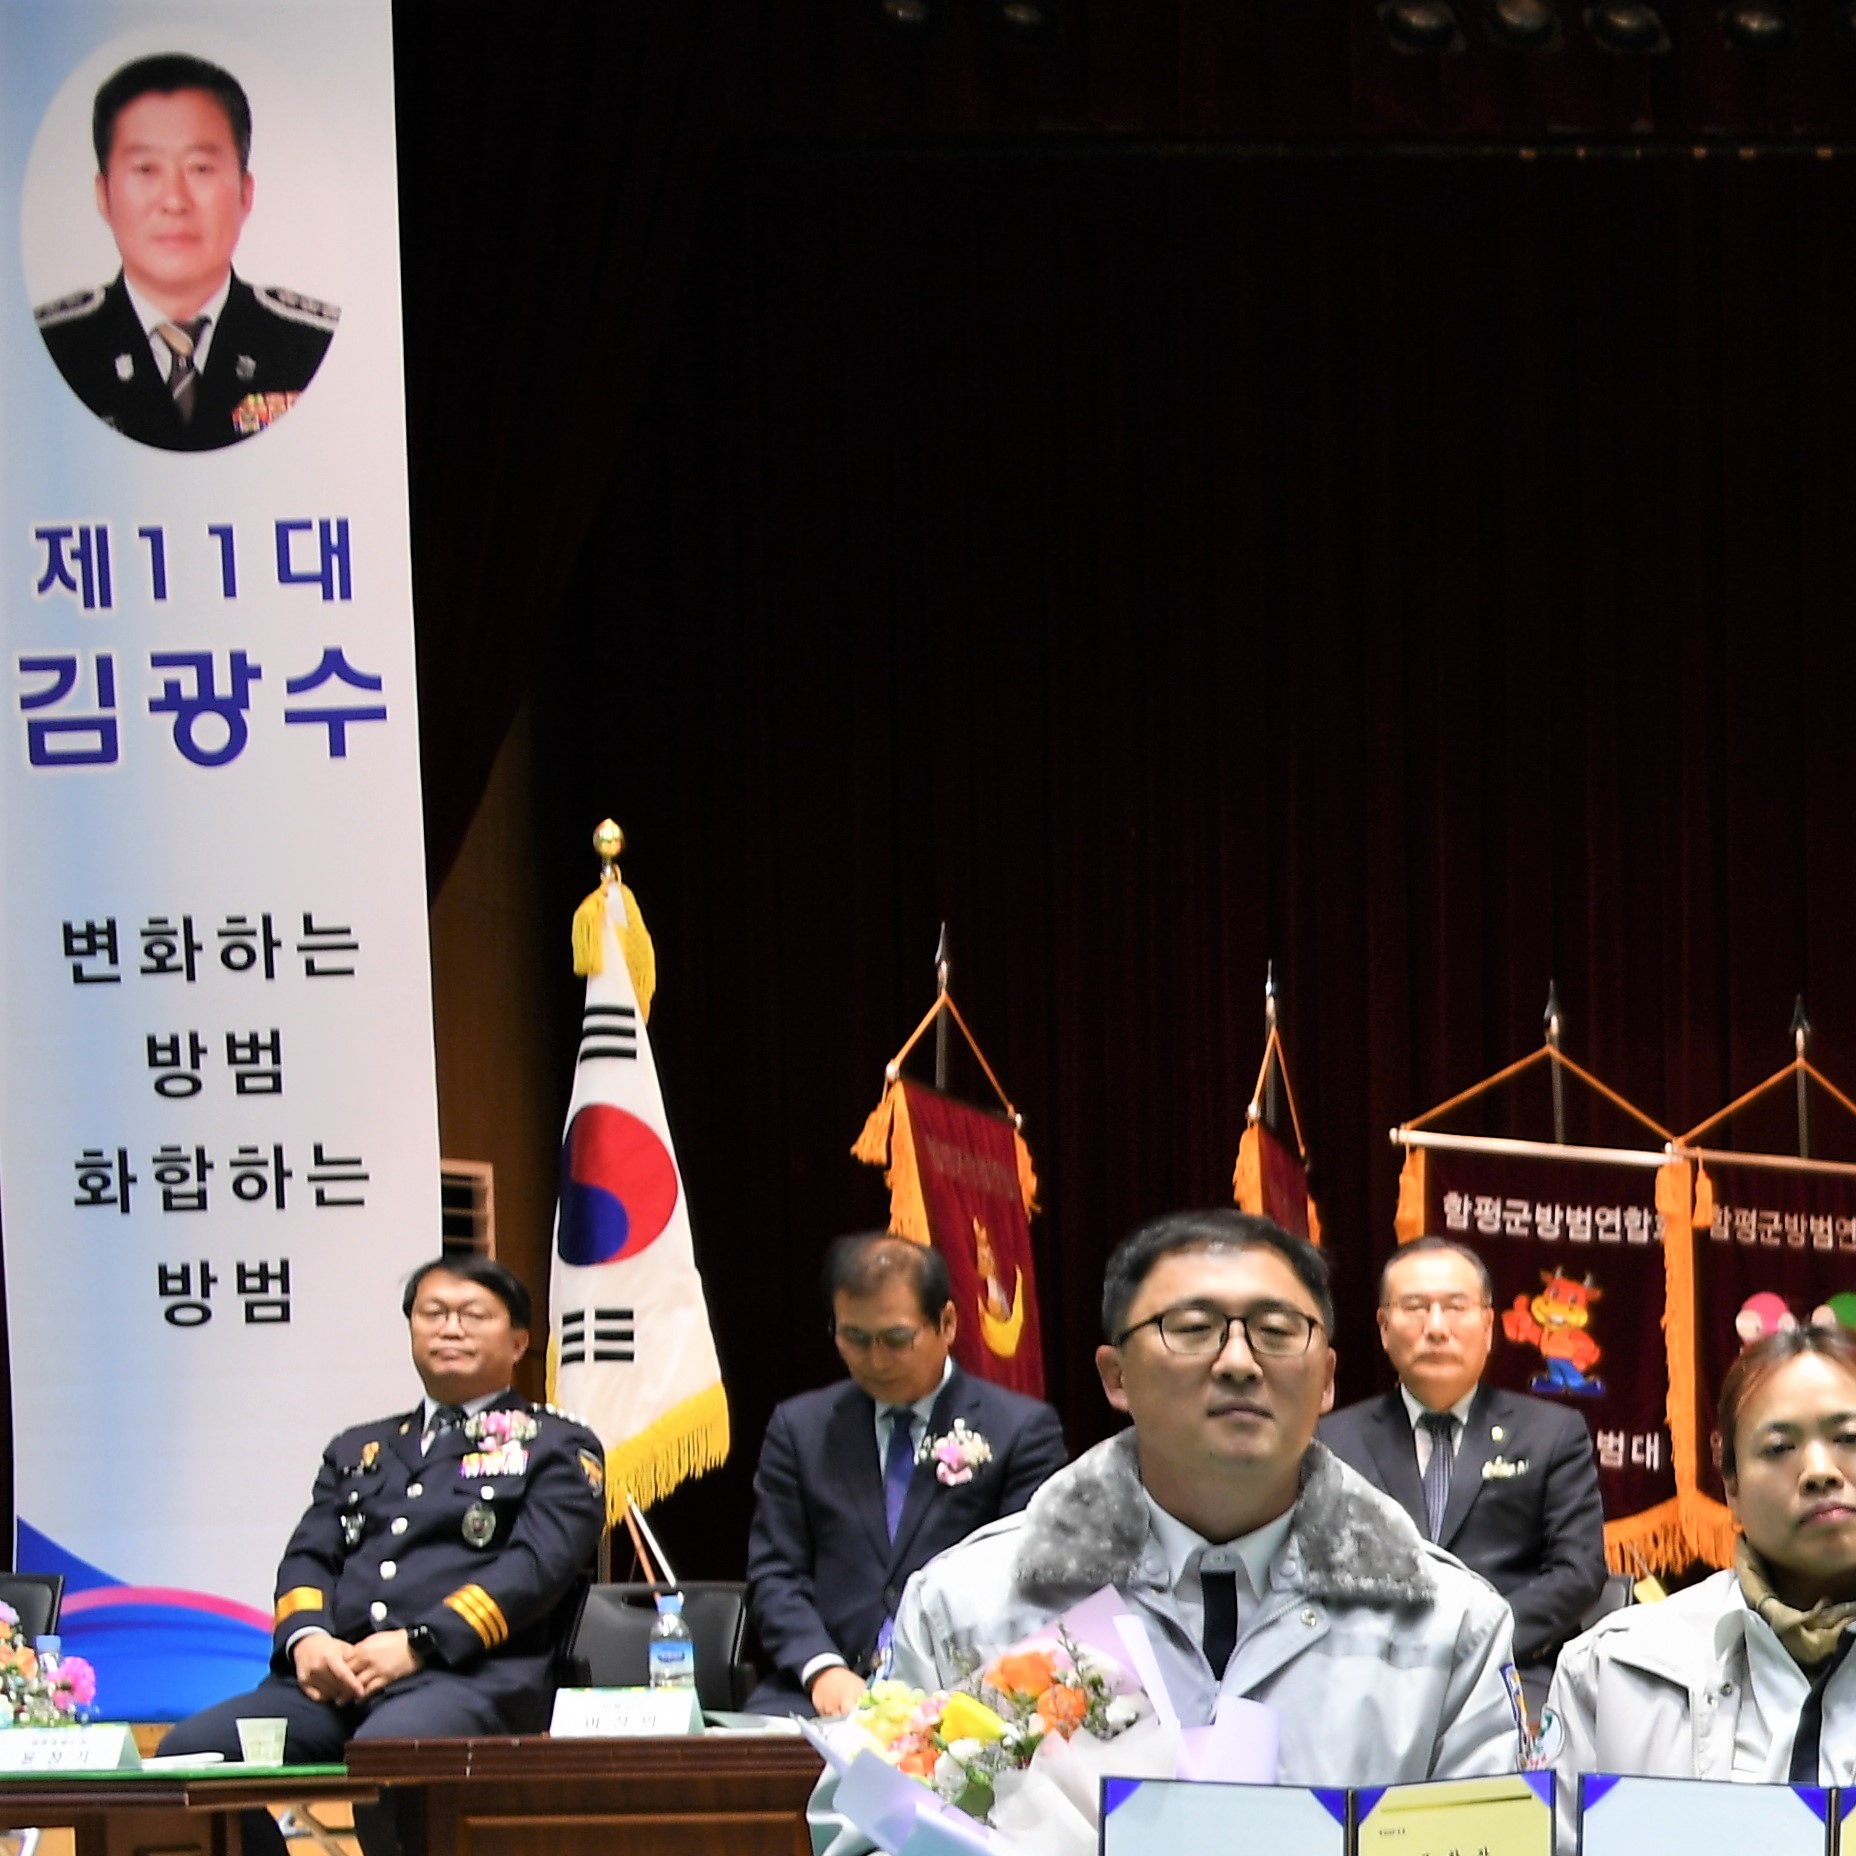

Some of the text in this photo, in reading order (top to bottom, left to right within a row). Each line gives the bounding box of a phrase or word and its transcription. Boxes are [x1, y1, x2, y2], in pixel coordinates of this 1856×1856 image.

[35, 519, 353, 609] 제11대
[19, 647, 387, 767] 김광수
[63, 912, 359, 985] 변화하는
[146, 1029, 283, 1098] 방범
[74, 1143, 369, 1214] 화합하는
[158, 1259, 290, 1327] 방범
[1596, 1430, 1660, 1471] 범대
